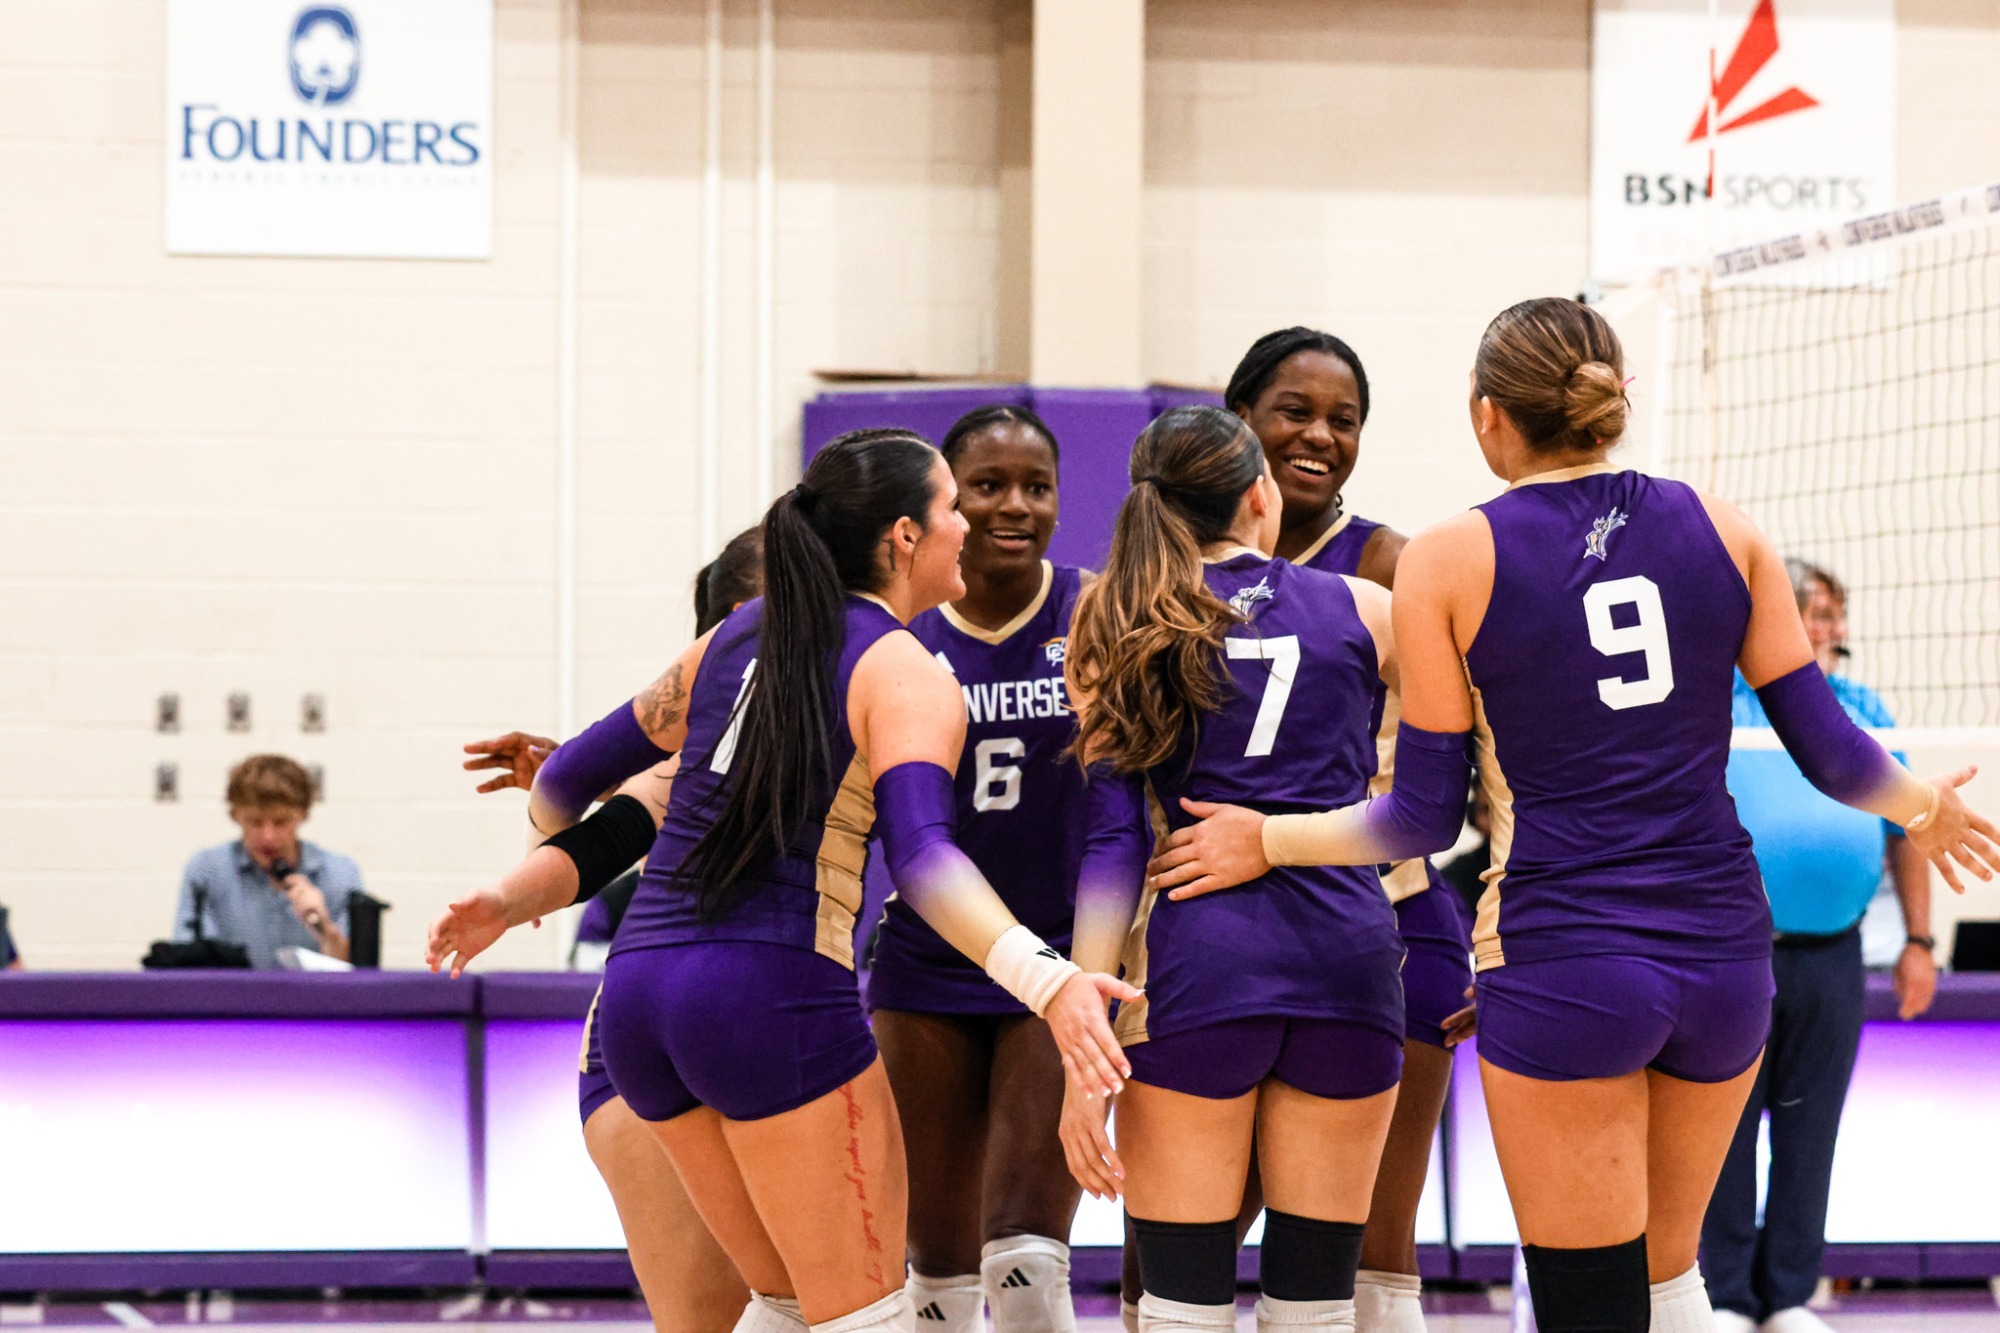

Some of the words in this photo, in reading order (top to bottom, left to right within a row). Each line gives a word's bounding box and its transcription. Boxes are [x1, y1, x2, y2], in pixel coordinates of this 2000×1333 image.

[181, 103, 480, 165] FOUNDERS
[1624, 174, 1712, 205] BSN
[1723, 174, 1868, 210] SPORTS
[1582, 575, 1675, 711] 9
[961, 677, 1070, 724] NVERSE
[1224, 635, 1301, 757] 7
[973, 737, 1026, 812] 6
